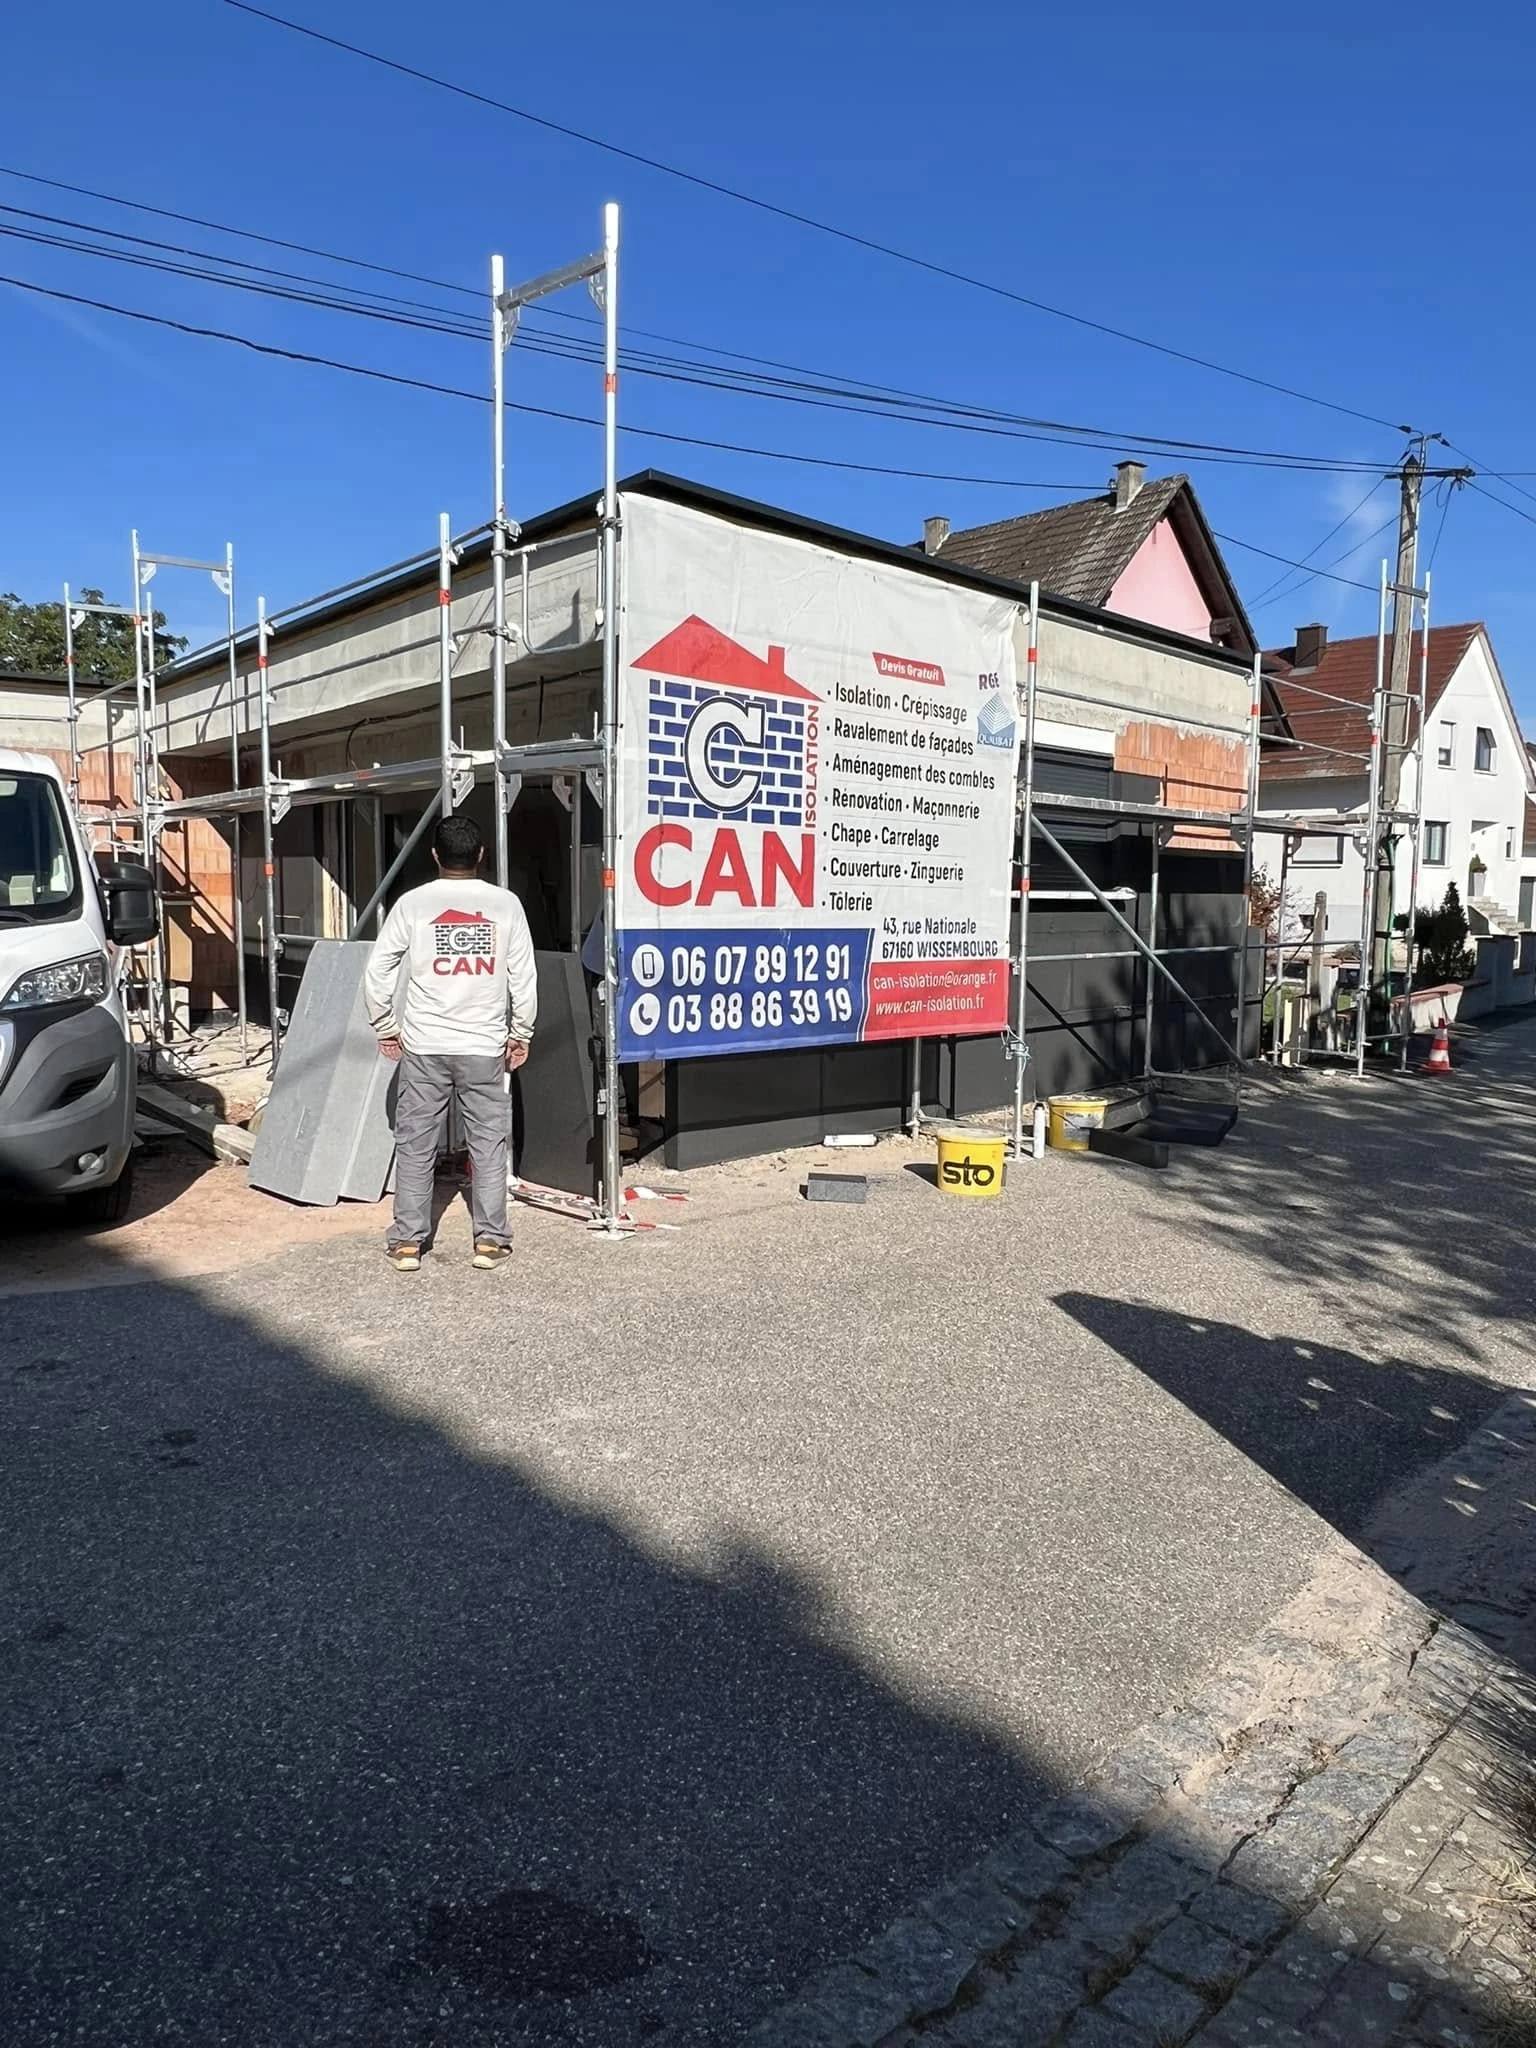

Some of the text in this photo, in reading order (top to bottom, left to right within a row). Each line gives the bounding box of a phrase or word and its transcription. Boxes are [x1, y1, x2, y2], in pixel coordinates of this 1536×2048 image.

[881, 658, 939, 681] Devis Gratuit
[979, 672, 1000, 690] RGE
[835, 682, 967, 725] Isolation Crépissage
[834, 717, 974, 756] Ravalement de façades
[805, 704, 819, 828] ISOLATION
[833, 753, 996, 790] Aménagement des combles
[833, 788, 980, 820] Rénovation Maçonnerie
[831, 823, 940, 851] Chape Carrelage
[634, 823, 815, 908] CAN
[830, 857, 964, 884] Couverture Zinguerie
[829, 891, 873, 911] Tôlerie
[883, 917, 977, 937] 43, rue Nationale
[882, 940, 998, 959] 67160 WISSEMBOURG
[433, 957, 495, 976] CAN
[671, 944, 850, 987] 06 07 89 12 91
[873, 968, 997, 989] can-isolation@orange.fr
[668, 987, 852, 1034] 03 88 86 39 19
[875, 993, 985, 1015] www.can-isolation.fr
[943, 1156, 995, 1187] sto
